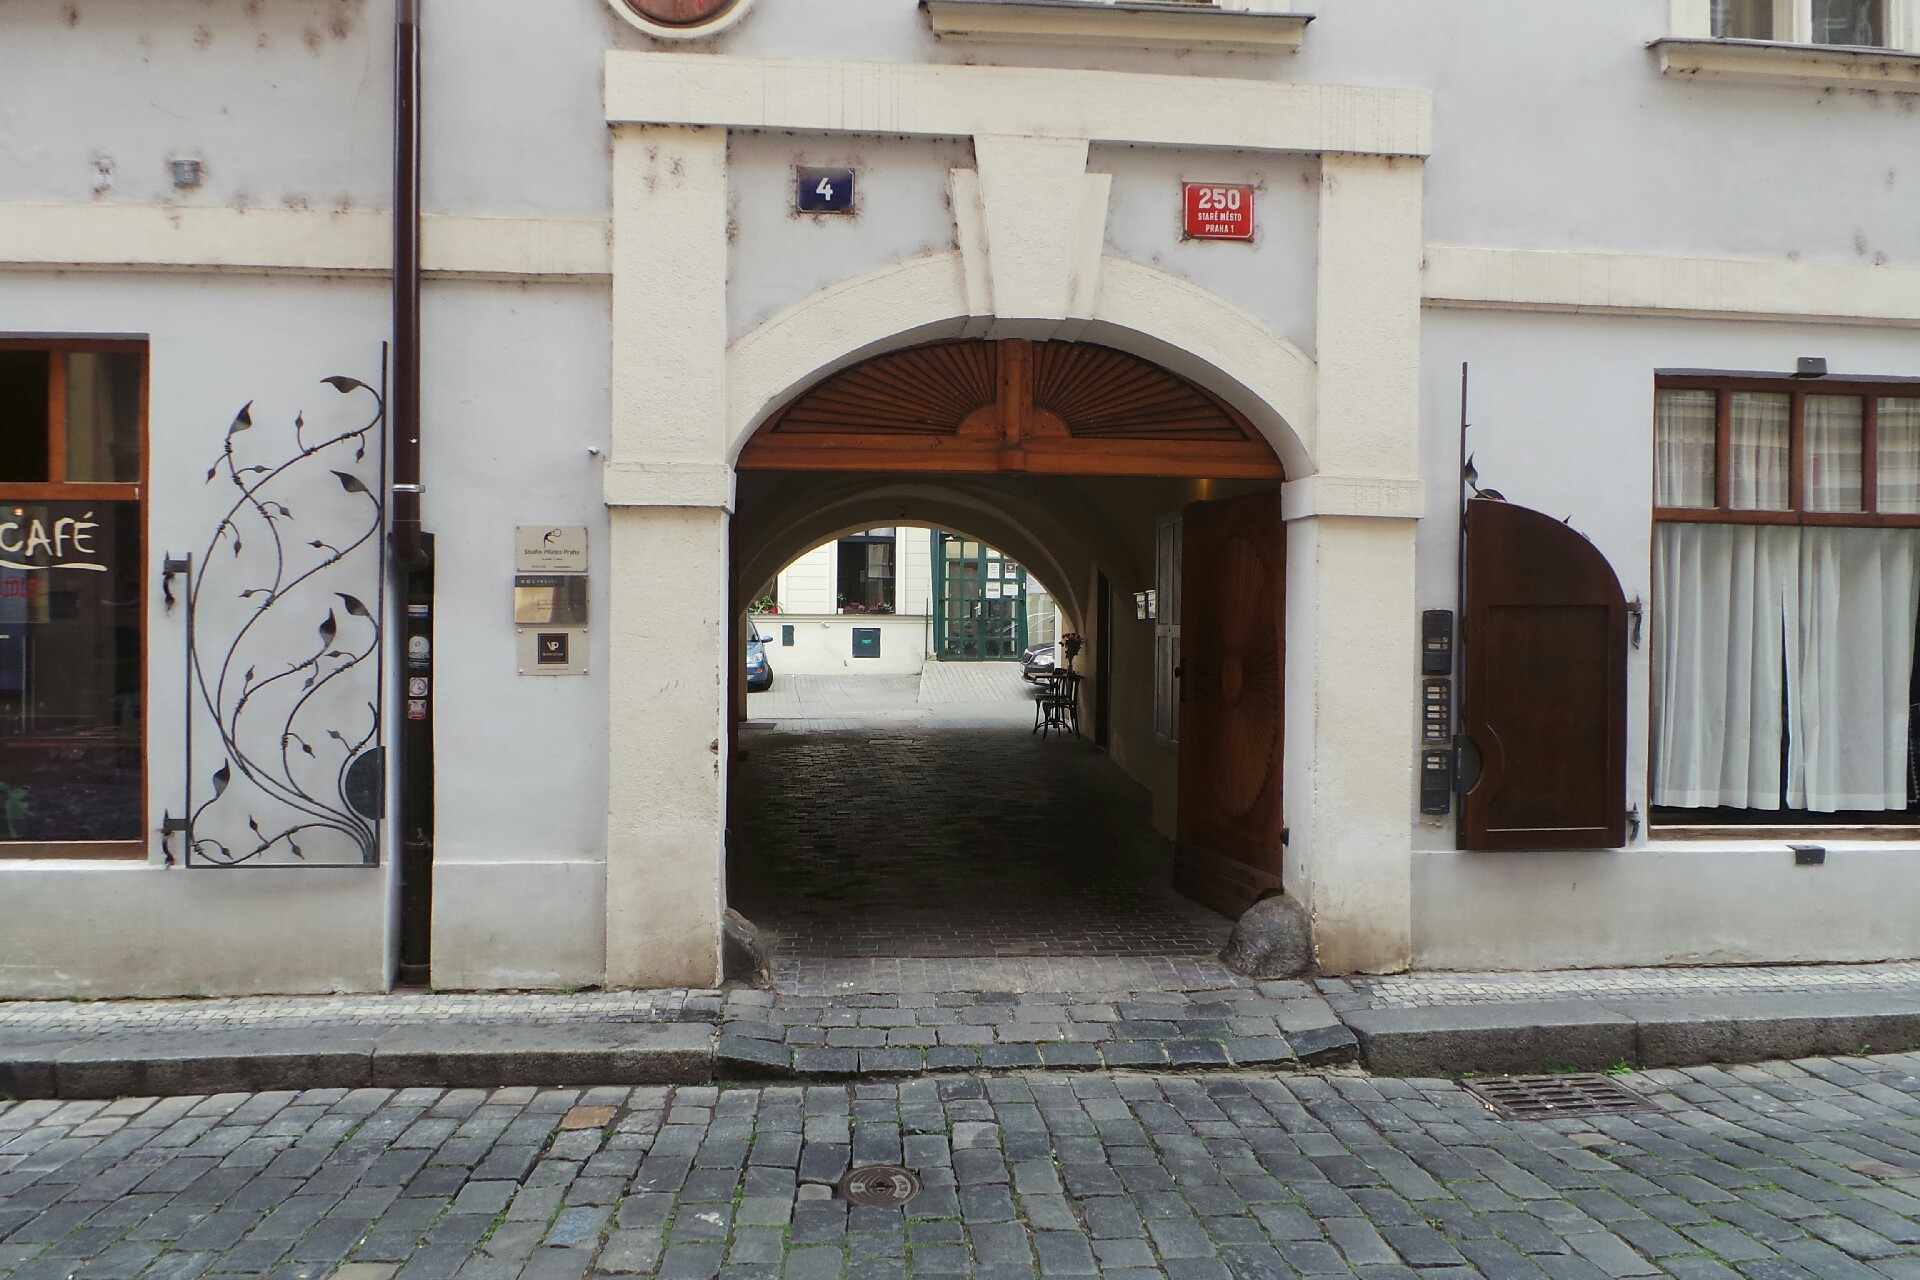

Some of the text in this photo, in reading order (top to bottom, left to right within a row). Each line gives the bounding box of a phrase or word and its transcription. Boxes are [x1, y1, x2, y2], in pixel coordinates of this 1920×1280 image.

[816, 177, 833, 201] 4
[1198, 188, 1241, 210] 250
[1198, 211, 1242, 221] STARÉ MĚSTO
[1205, 224, 1234, 233] PRAHA 1
[0, 511, 99, 557] CAFÉ
